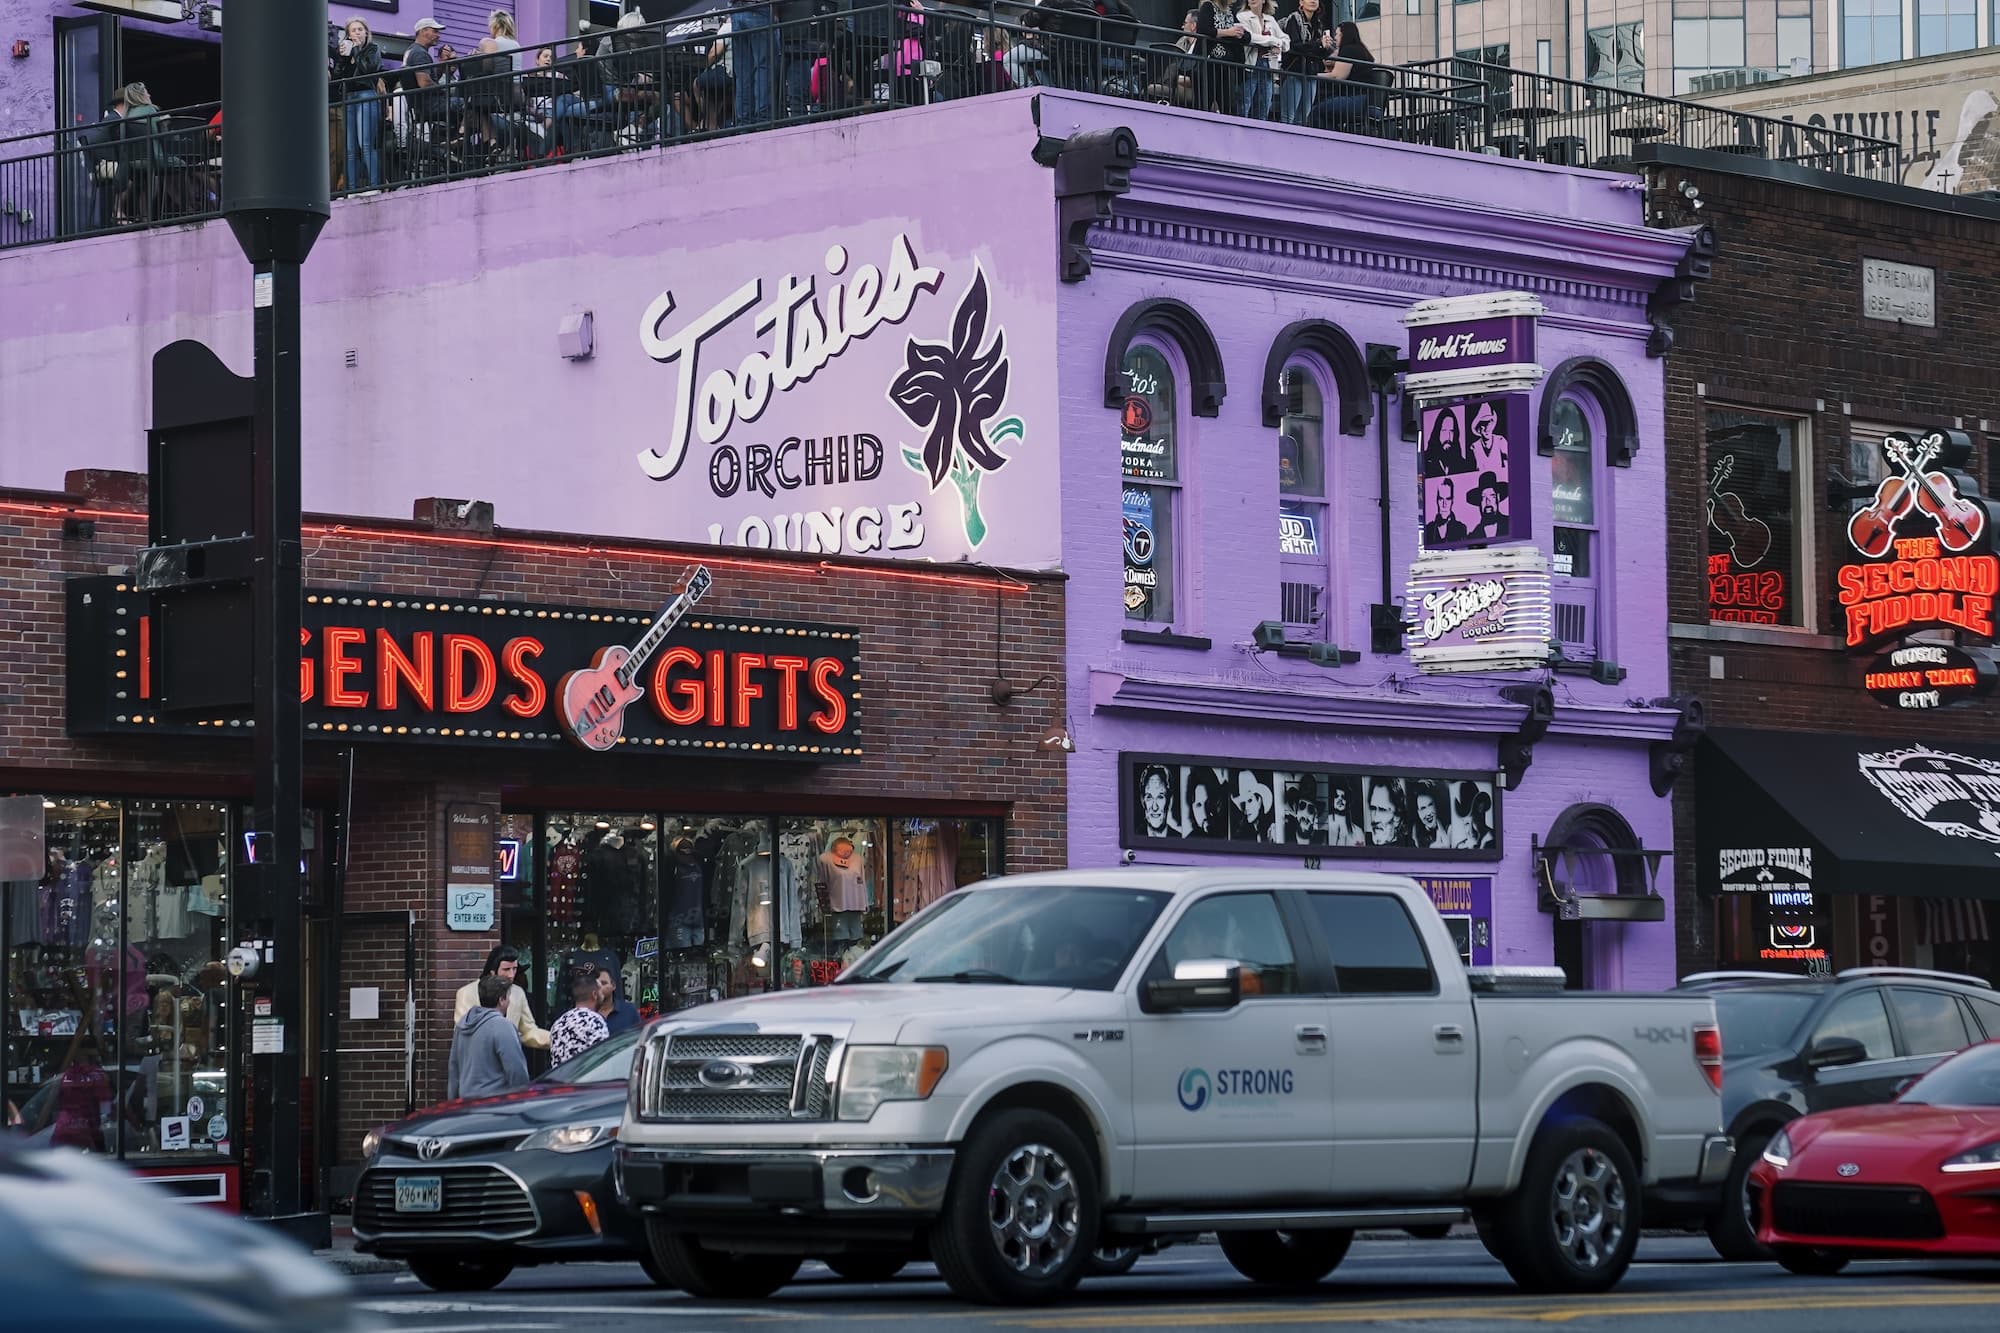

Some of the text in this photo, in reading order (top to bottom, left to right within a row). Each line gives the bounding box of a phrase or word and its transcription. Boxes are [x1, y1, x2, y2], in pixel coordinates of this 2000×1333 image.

[1737, 108, 1940, 176] NASHVILLE
[637, 233, 945, 481] Tootsies
[1417, 333, 1507, 361] World Famous
[709, 432, 884, 500] ORCHID
[1894, 536, 1942, 561] THE
[1837, 555, 2000, 606] SECOND
[1423, 579, 1506, 641] Tootsies
[1845, 592, 1993, 647] FIDDLE
[1462, 623, 1504, 639] LOUNGE
[1891, 646, 1948, 667] MUSIC
[649, 645, 848, 735] GIFTS
[1865, 668, 1977, 689] HONKY TONK
[1899, 690, 1941, 709] CITY
[1875, 769, 1972, 819] SECOND
[1719, 847, 1813, 880] SECOND FIDDLE
[1432, 880, 1472, 911] FAMOUS
[454, 913, 487, 924] ENTER HERE
[1217, 1069, 1294, 1095] STRONG
[398, 1187, 415, 1204] 296
